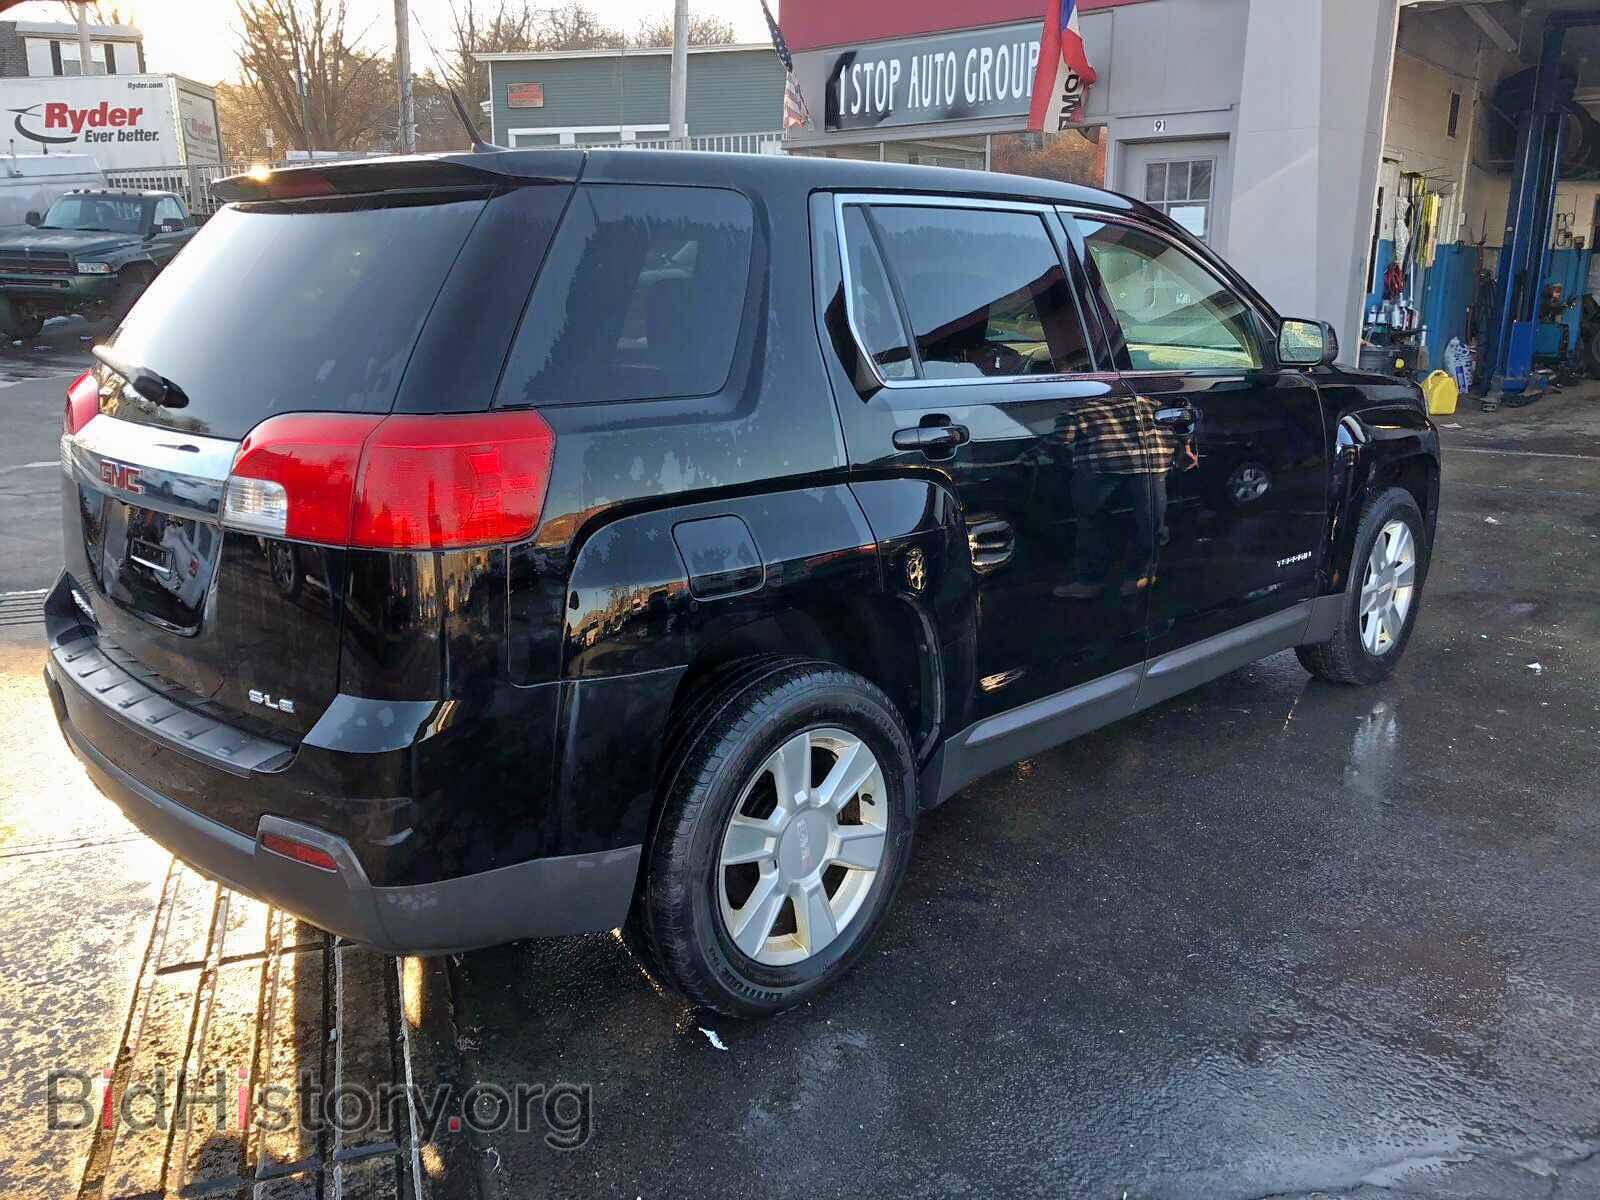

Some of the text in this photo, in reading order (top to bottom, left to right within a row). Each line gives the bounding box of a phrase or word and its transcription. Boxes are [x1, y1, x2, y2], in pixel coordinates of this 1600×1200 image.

[838, 41, 1041, 115] 1 STOP AUTO GROUP
[44, 101, 143, 134] Ryder
[1155, 120, 1166, 131] 91
[84, 129, 159, 143] Ever better.
[100, 460, 144, 494] GMC
